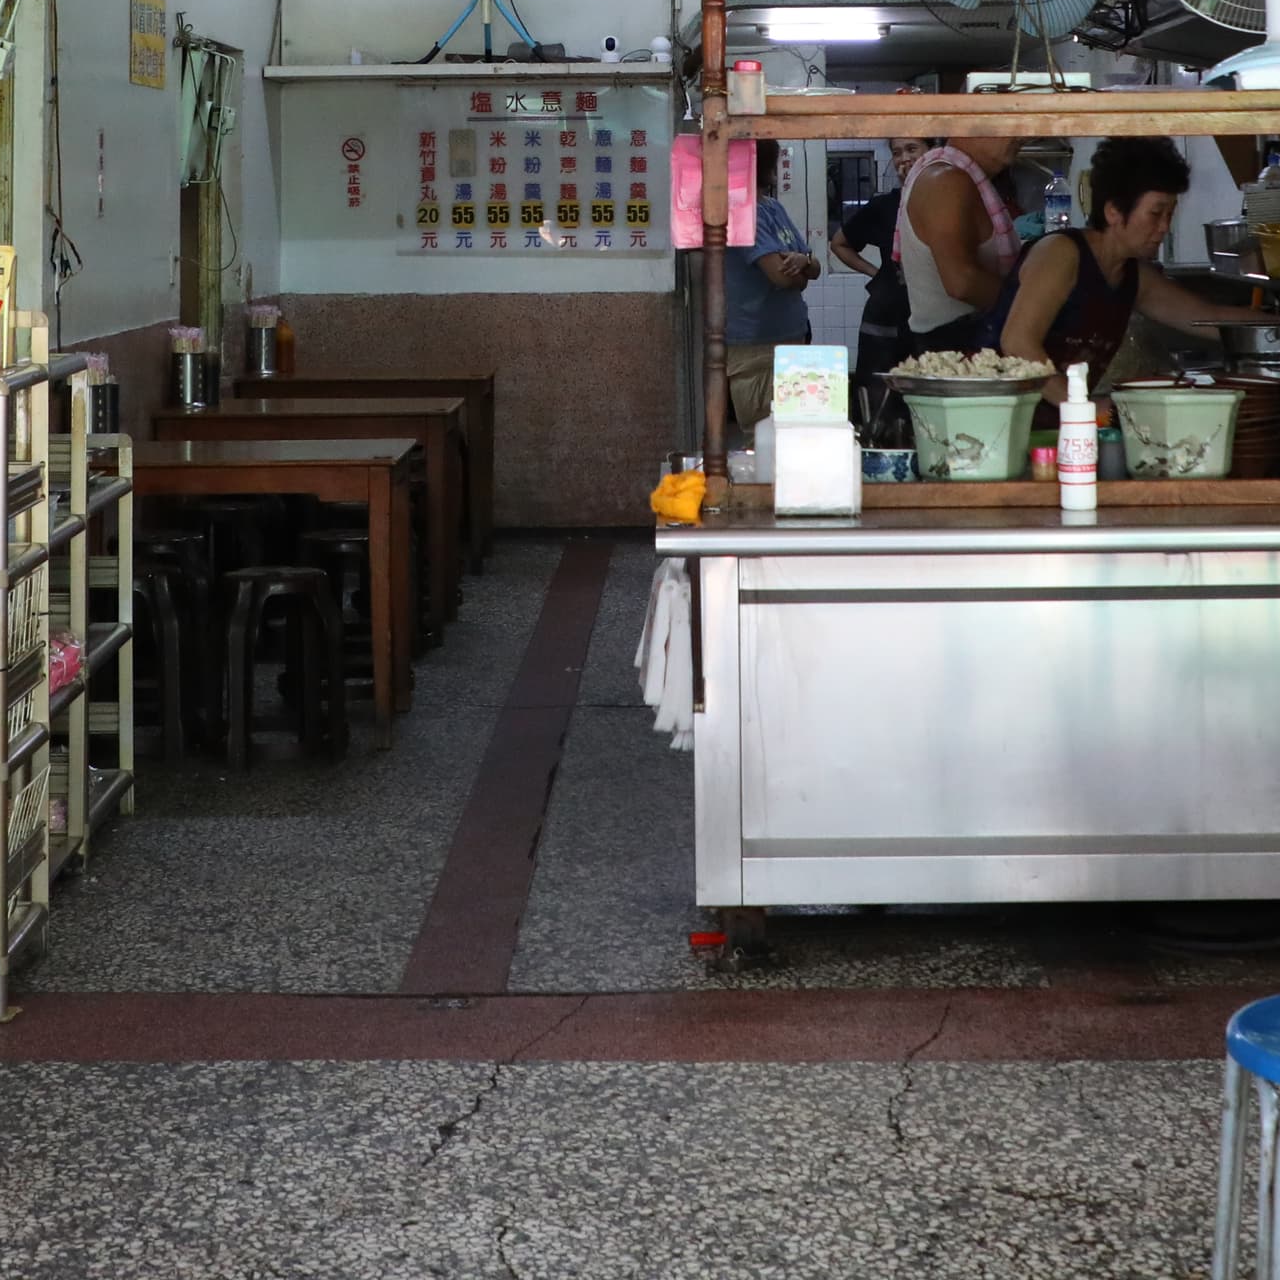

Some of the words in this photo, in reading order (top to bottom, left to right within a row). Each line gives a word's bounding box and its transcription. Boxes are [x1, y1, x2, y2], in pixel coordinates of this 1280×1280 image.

[470, 91, 598, 114] 塩水意麵
[418, 208, 439, 224] 20
[451, 205, 474, 224] 55
[487, 205, 510, 223] 55
[521, 205, 544, 223] 55
[557, 205, 580, 223] 55
[592, 205, 614, 223] 55
[627, 205, 649, 223] 55
[421, 232, 438, 249] 元
[455, 232, 473, 249] 元
[490, 232, 507, 249] 元
[595, 231, 612, 248] 元
[630, 231, 648, 248] 元
